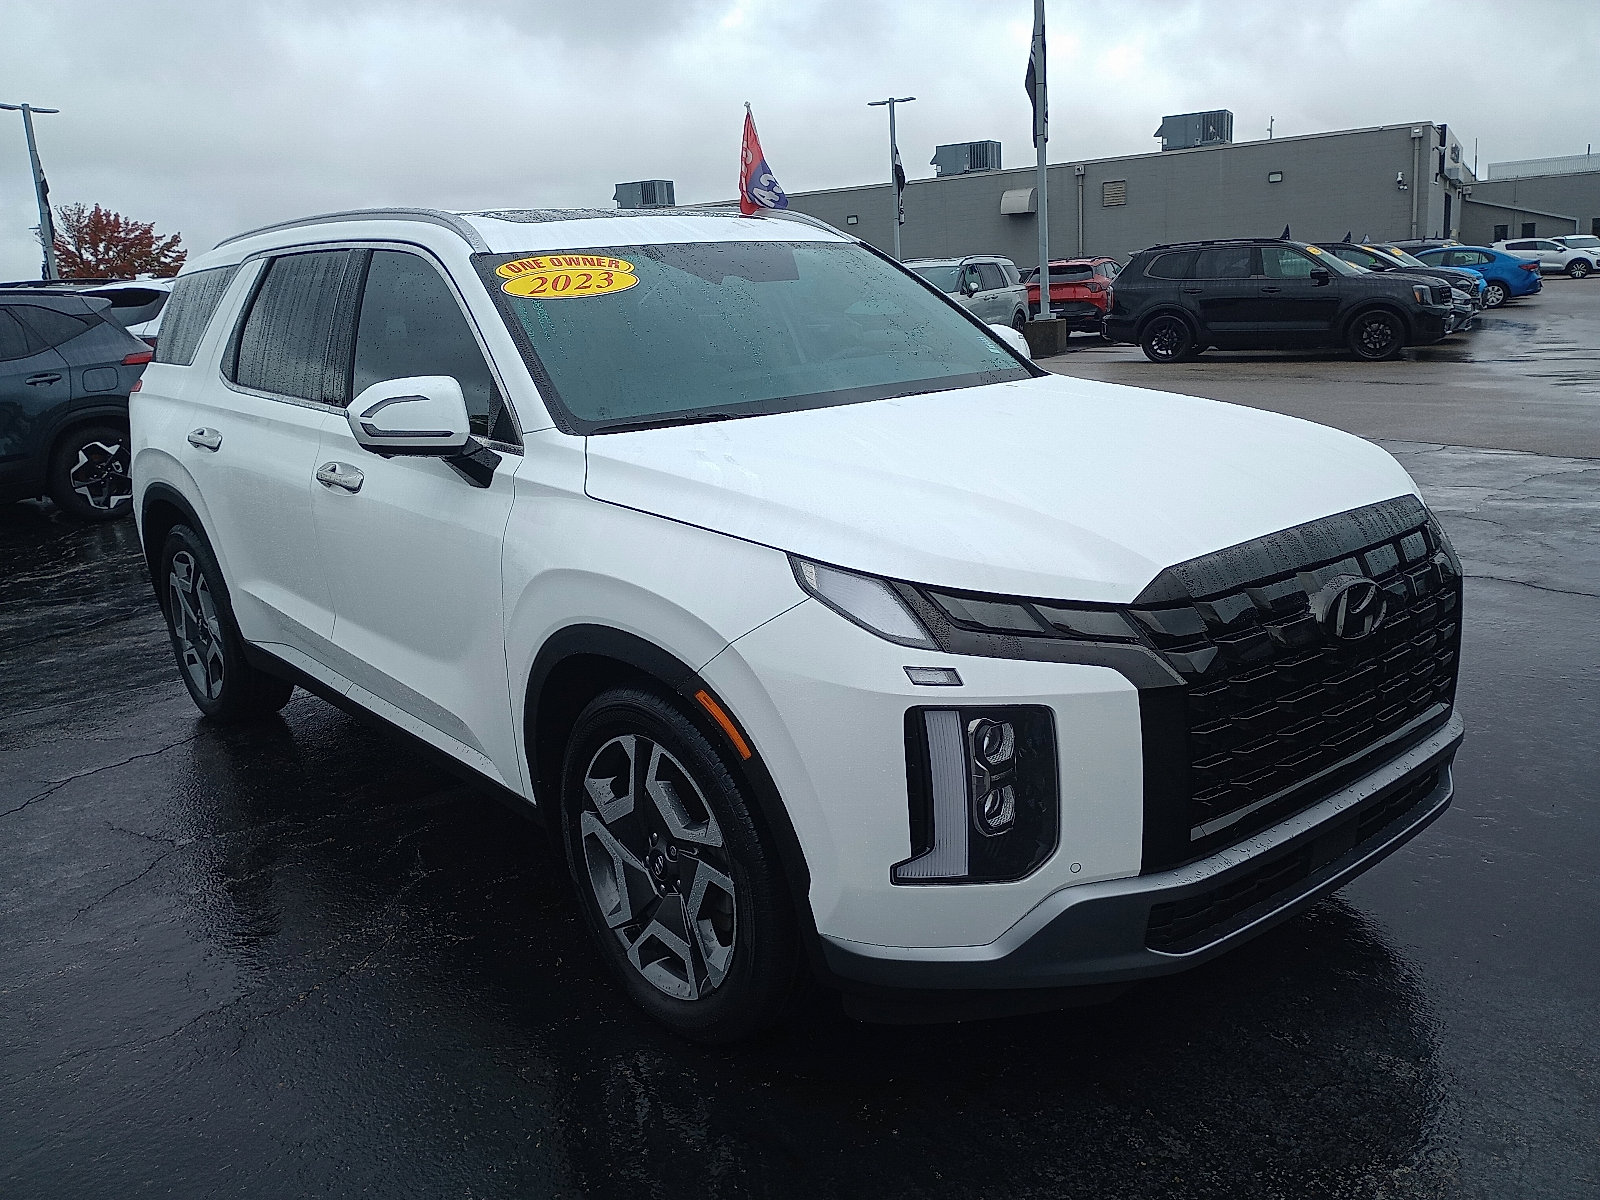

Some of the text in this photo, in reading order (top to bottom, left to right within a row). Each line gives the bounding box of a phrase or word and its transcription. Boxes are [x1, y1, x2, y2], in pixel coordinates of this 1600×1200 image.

[505, 256, 621, 274] ONE OWNER
[528, 271, 614, 295] 2023
